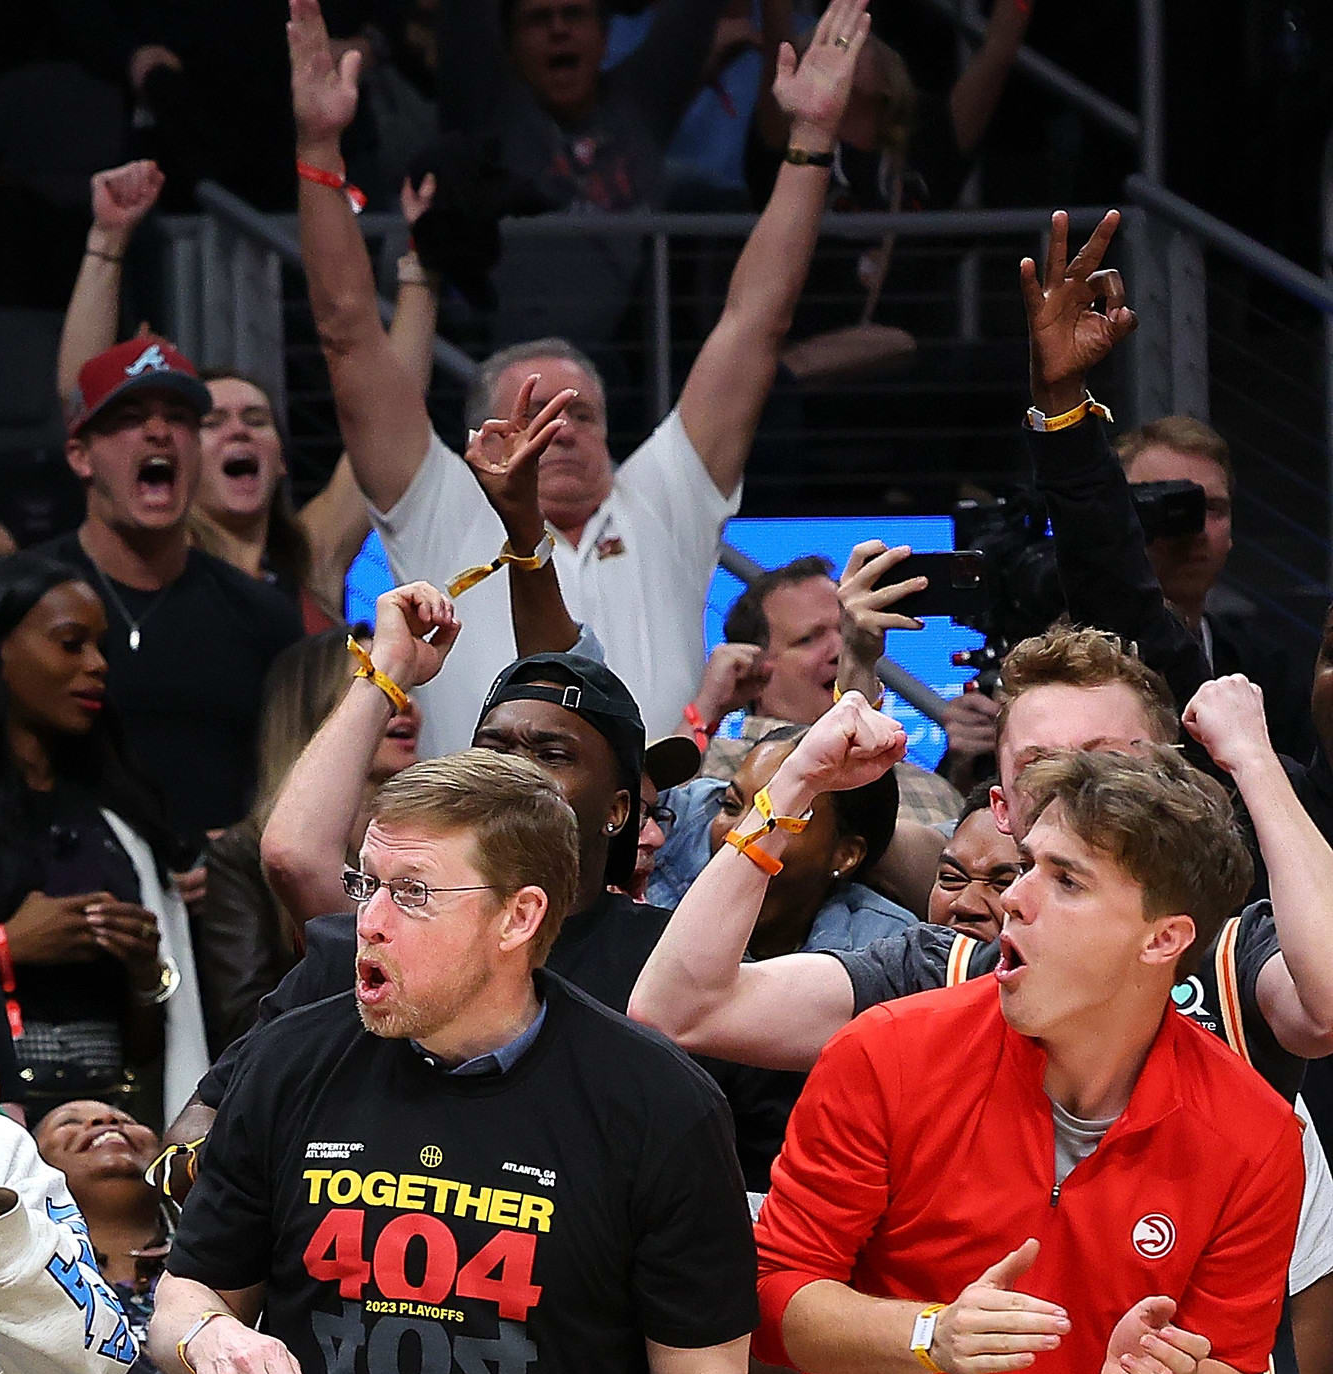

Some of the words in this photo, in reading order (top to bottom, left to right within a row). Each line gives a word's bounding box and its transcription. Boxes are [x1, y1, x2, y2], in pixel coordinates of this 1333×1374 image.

[302, 1170, 555, 1233] TOGETHER
[537, 1177, 555, 1187] 404
[302, 1208, 543, 1323] 404
[365, 1300, 397, 1314] 2023
[399, 1302, 465, 1323] PLAYOFFS
